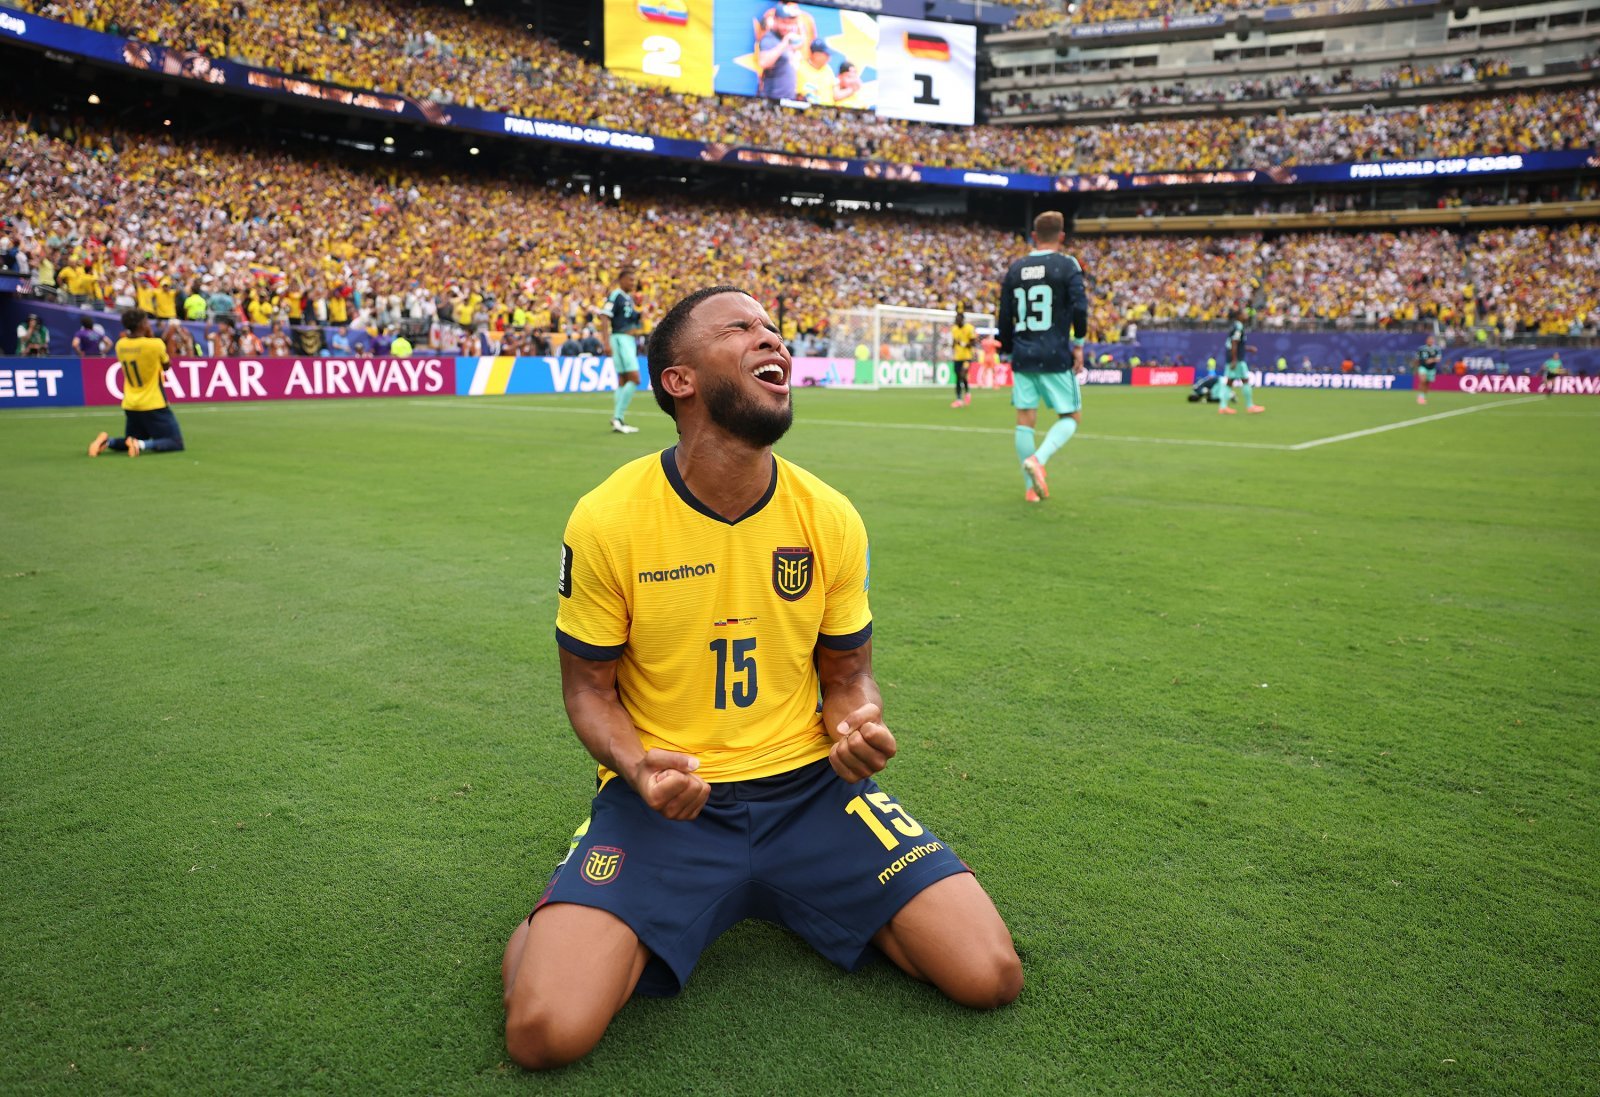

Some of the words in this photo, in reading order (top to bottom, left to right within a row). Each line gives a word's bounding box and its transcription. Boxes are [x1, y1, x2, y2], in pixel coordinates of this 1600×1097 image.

[641, 35, 682, 78] 2
[913, 73, 941, 106] 1
[583, 128, 610, 144] CUP
[1350, 164, 1382, 178] FIFA
[1382, 160, 1436, 176] WORLD
[1435, 158, 1467, 174] CUP
[1013, 284, 1053, 331] 13
[122, 360, 143, 388] 11
[284, 359, 443, 396] AIRWAYS
[543, 357, 618, 392] VISA
[878, 361, 950, 385] aramo
[1459, 375, 1531, 394] QATAR
[638, 563, 715, 583] marathon
[709, 637, 758, 710] 15
[845, 792, 923, 851] 15
[878, 841, 944, 885] marathon
